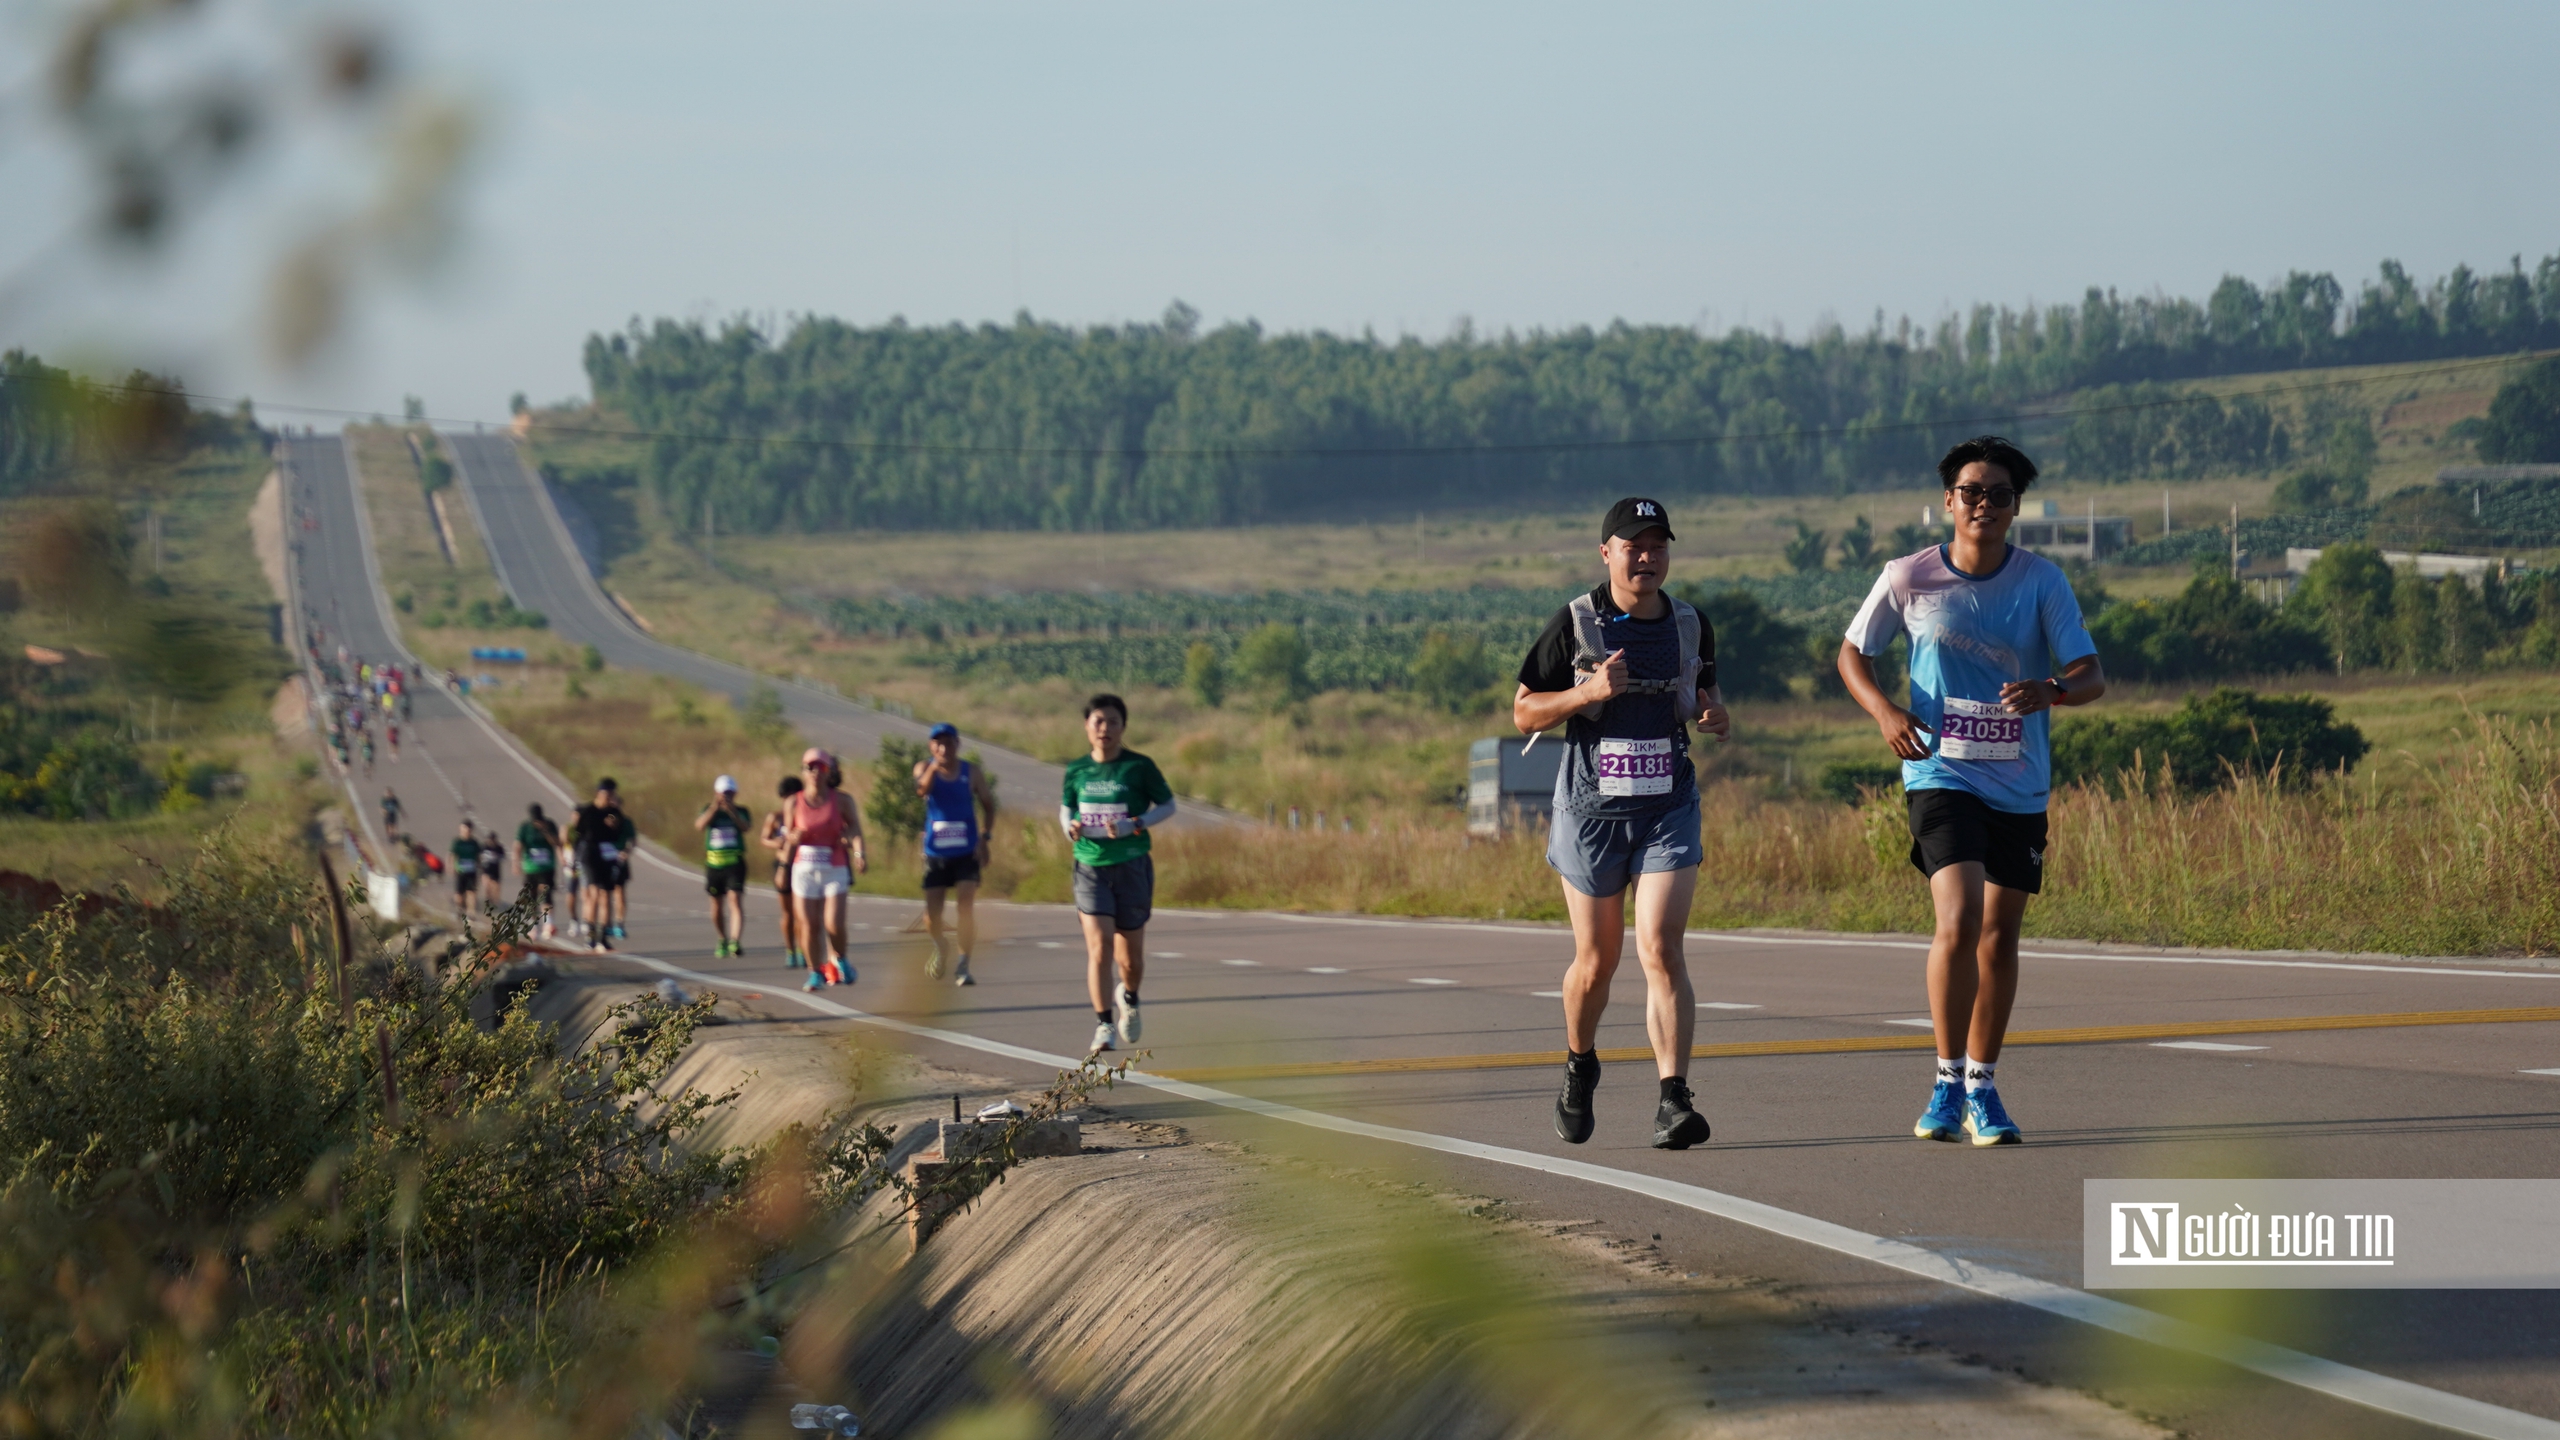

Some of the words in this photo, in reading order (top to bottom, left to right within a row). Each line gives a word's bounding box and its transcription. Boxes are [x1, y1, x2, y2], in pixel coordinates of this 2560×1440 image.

[1932, 623, 1977, 652] PHAN
[1971, 704, 2003, 716] 21KM
[1950, 718, 2012, 740] 21051
[1626, 742, 1657, 752] 21KM
[1608, 756, 1666, 775] 21181
